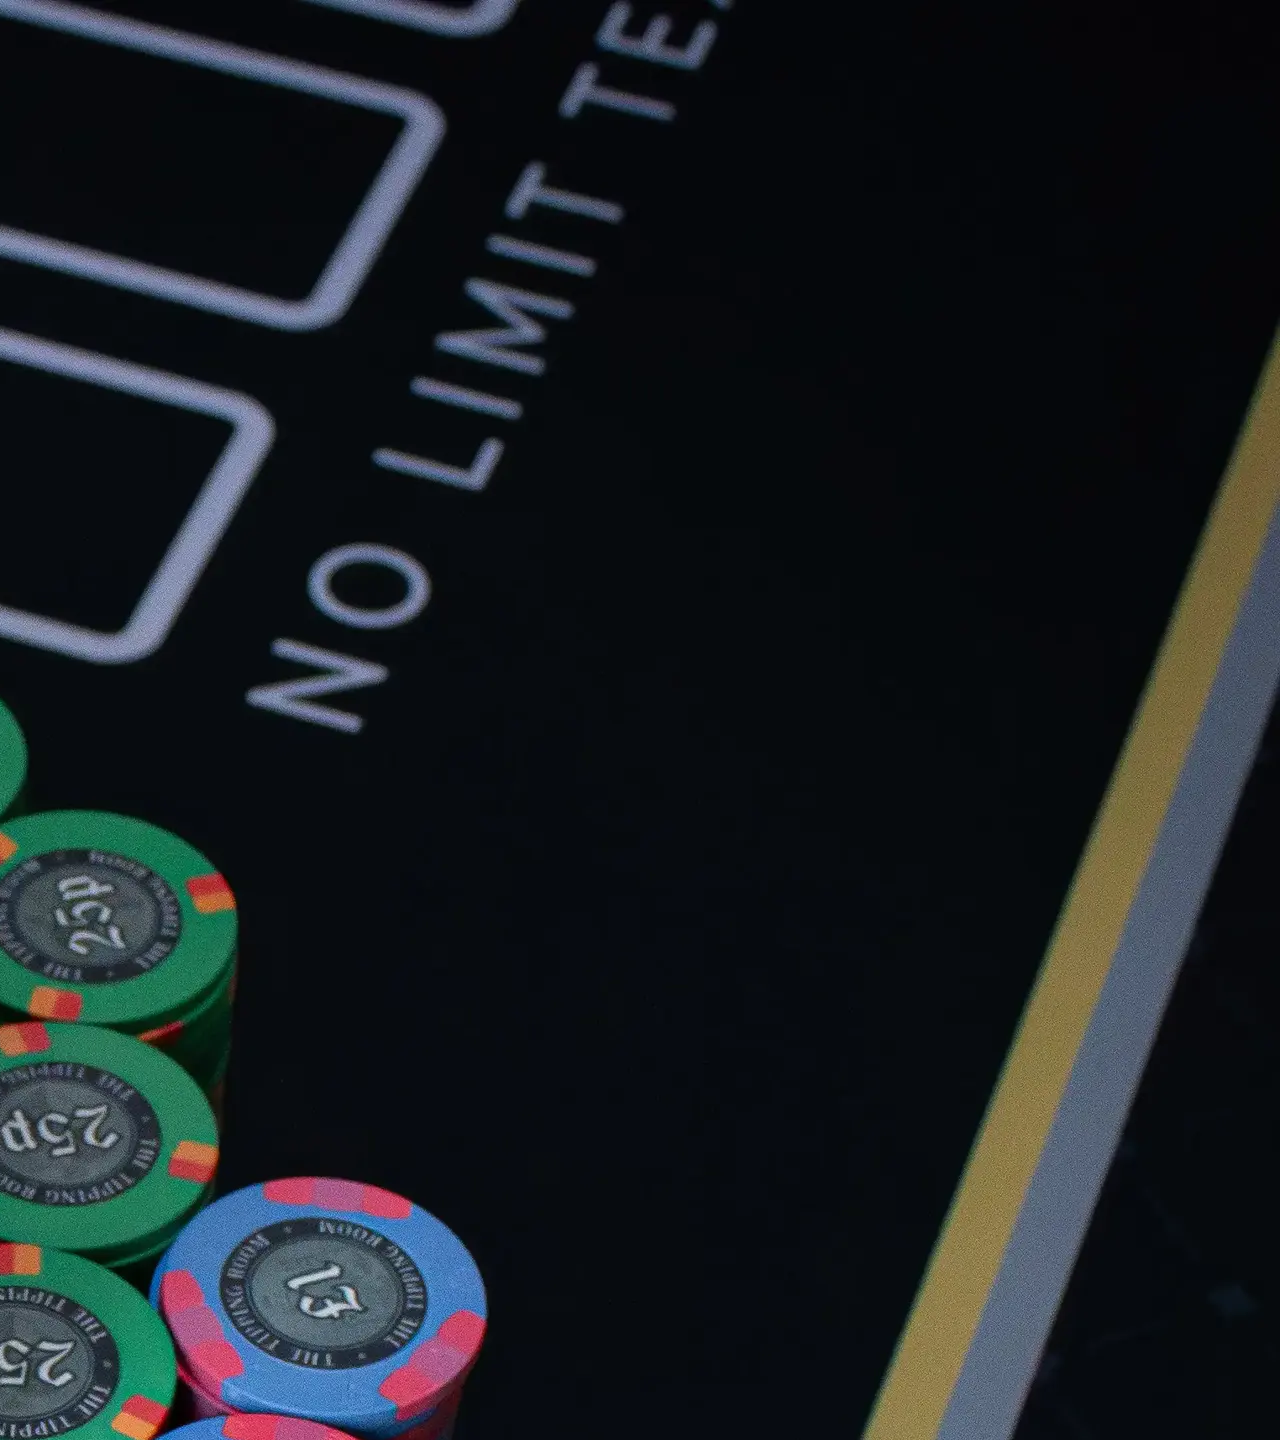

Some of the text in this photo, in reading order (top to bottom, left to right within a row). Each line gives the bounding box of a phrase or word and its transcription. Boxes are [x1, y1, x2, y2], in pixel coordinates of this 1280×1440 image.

[246, 0, 732, 732] NO LIMIT TE
[55, 875, 126, 955] 25p
[0, 1105, 118, 1157] 25p
[287, 1265, 361, 1318] £1
